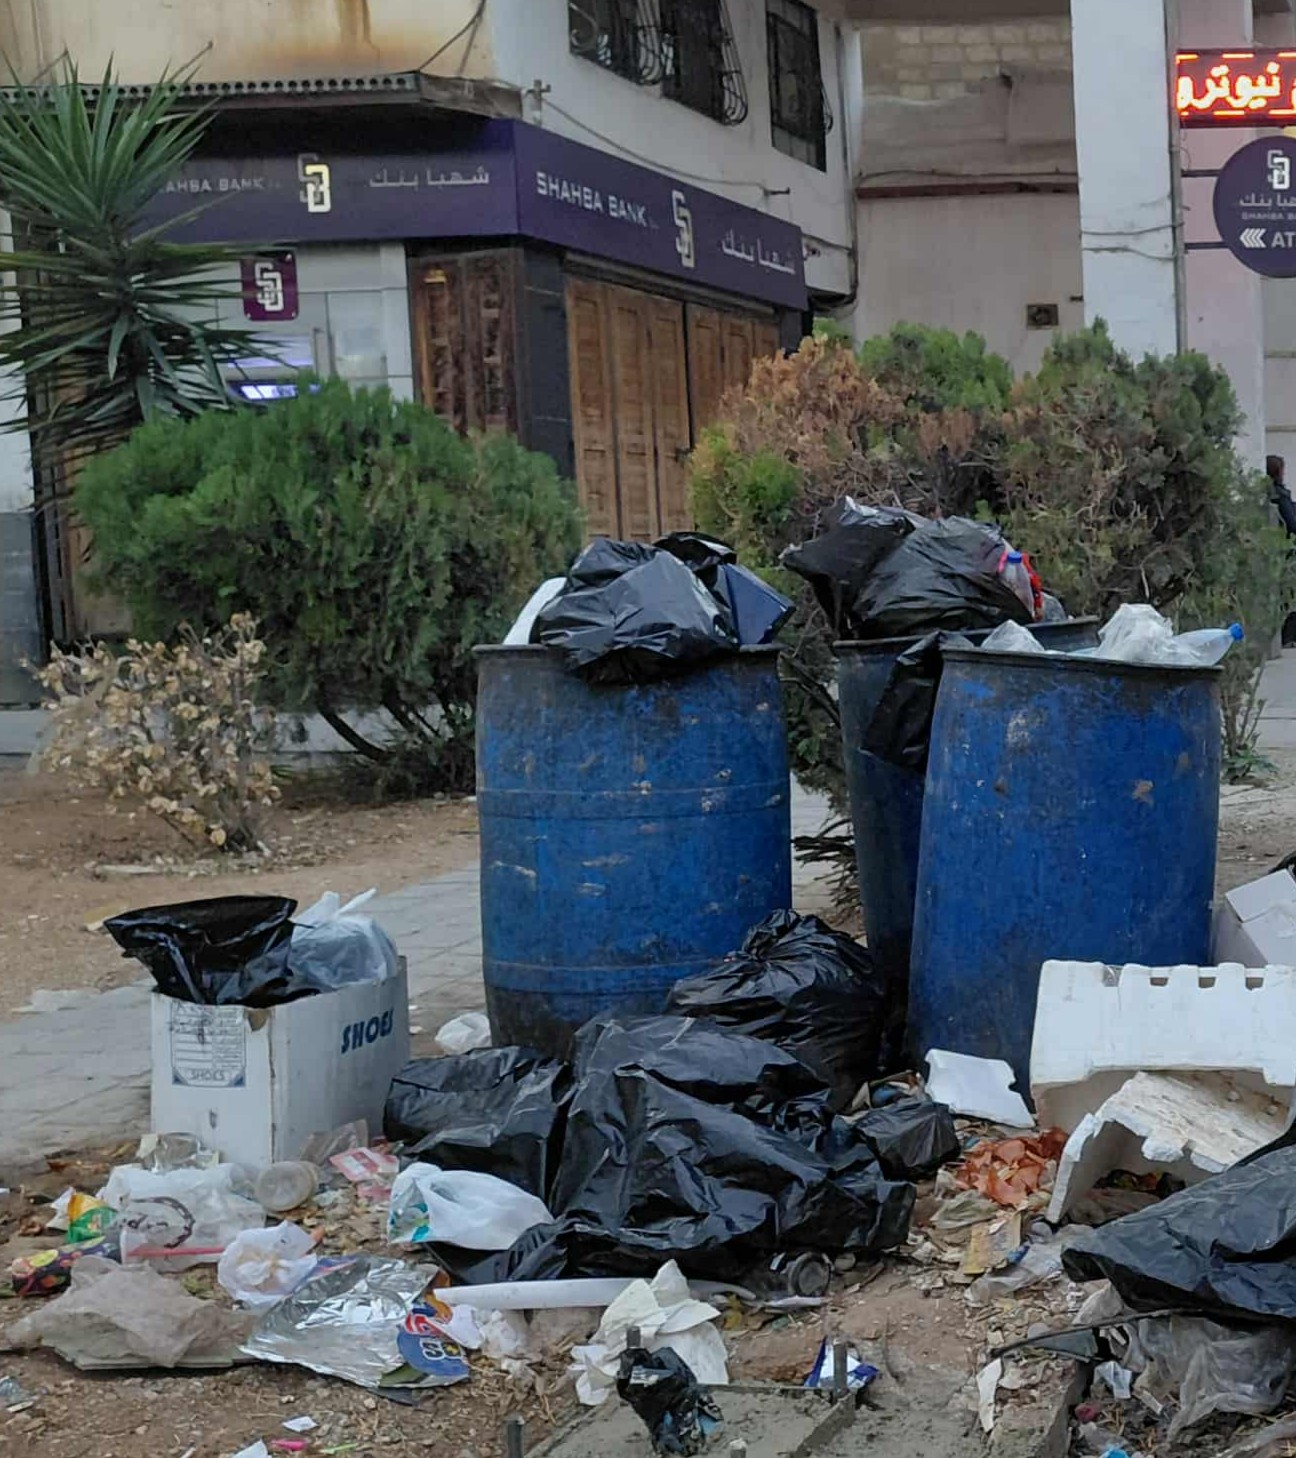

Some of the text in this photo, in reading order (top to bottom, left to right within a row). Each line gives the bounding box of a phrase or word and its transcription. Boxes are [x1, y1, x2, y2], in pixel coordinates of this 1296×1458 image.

[163, 177, 213, 194] AHBA
[218, 176, 266, 193] BANK
[368, 165, 490, 191] شهبا بنك
[535, 170, 648, 228] SHAHBA BANK
[1239, 192, 1273, 210] بنك
[341, 1006, 395, 1054] SHOES
